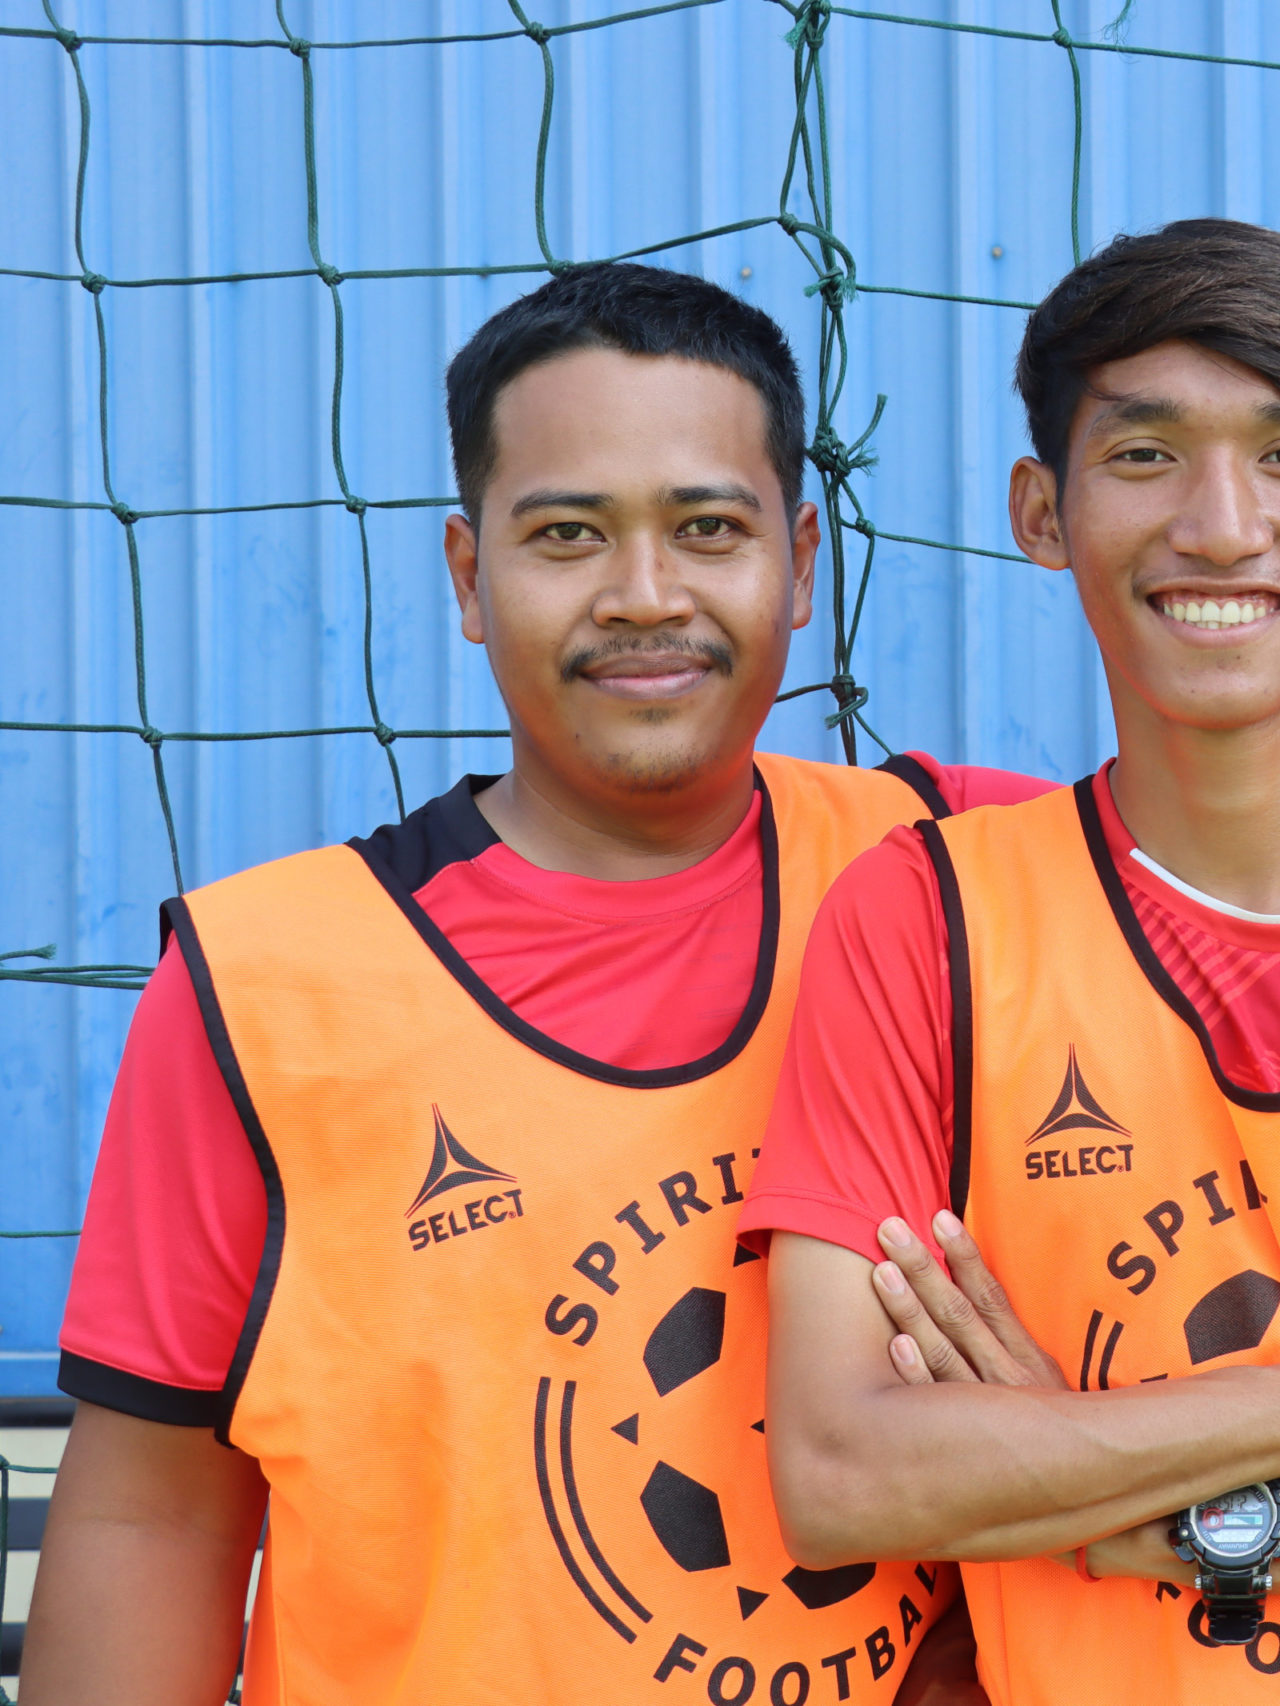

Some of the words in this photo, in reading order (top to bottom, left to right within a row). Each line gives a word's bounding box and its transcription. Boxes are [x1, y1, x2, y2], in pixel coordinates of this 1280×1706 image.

[1025, 1144, 1134, 1180] SELECT
[408, 1189, 524, 1252] SELECT
[545, 1147, 761, 1347] SPIRI
[653, 1562, 937, 1706] FOOTBAL
